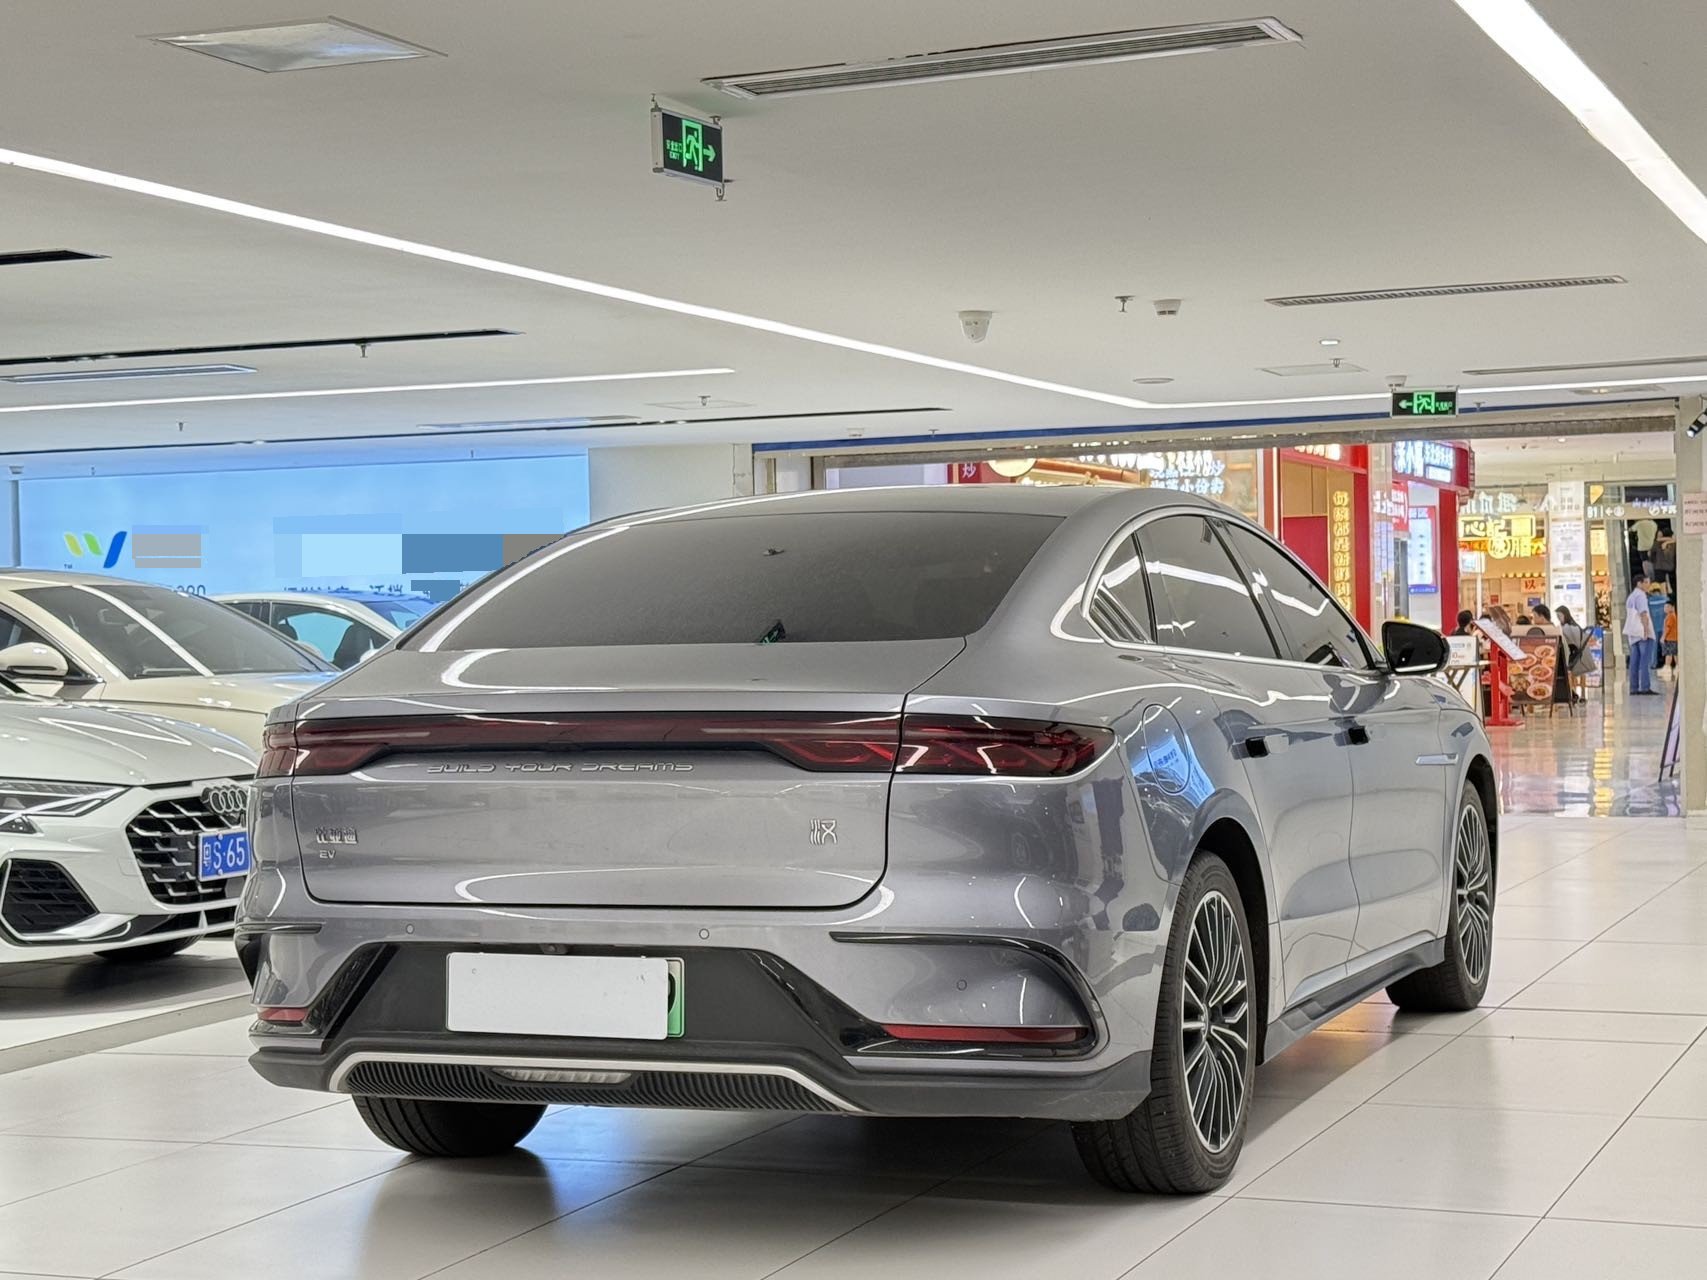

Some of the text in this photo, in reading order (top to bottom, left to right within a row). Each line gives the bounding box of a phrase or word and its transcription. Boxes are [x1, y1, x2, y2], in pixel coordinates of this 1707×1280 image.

[426, 762, 694, 774] BUILD YOUR DREAMS
[319, 849, 336, 859] EV
